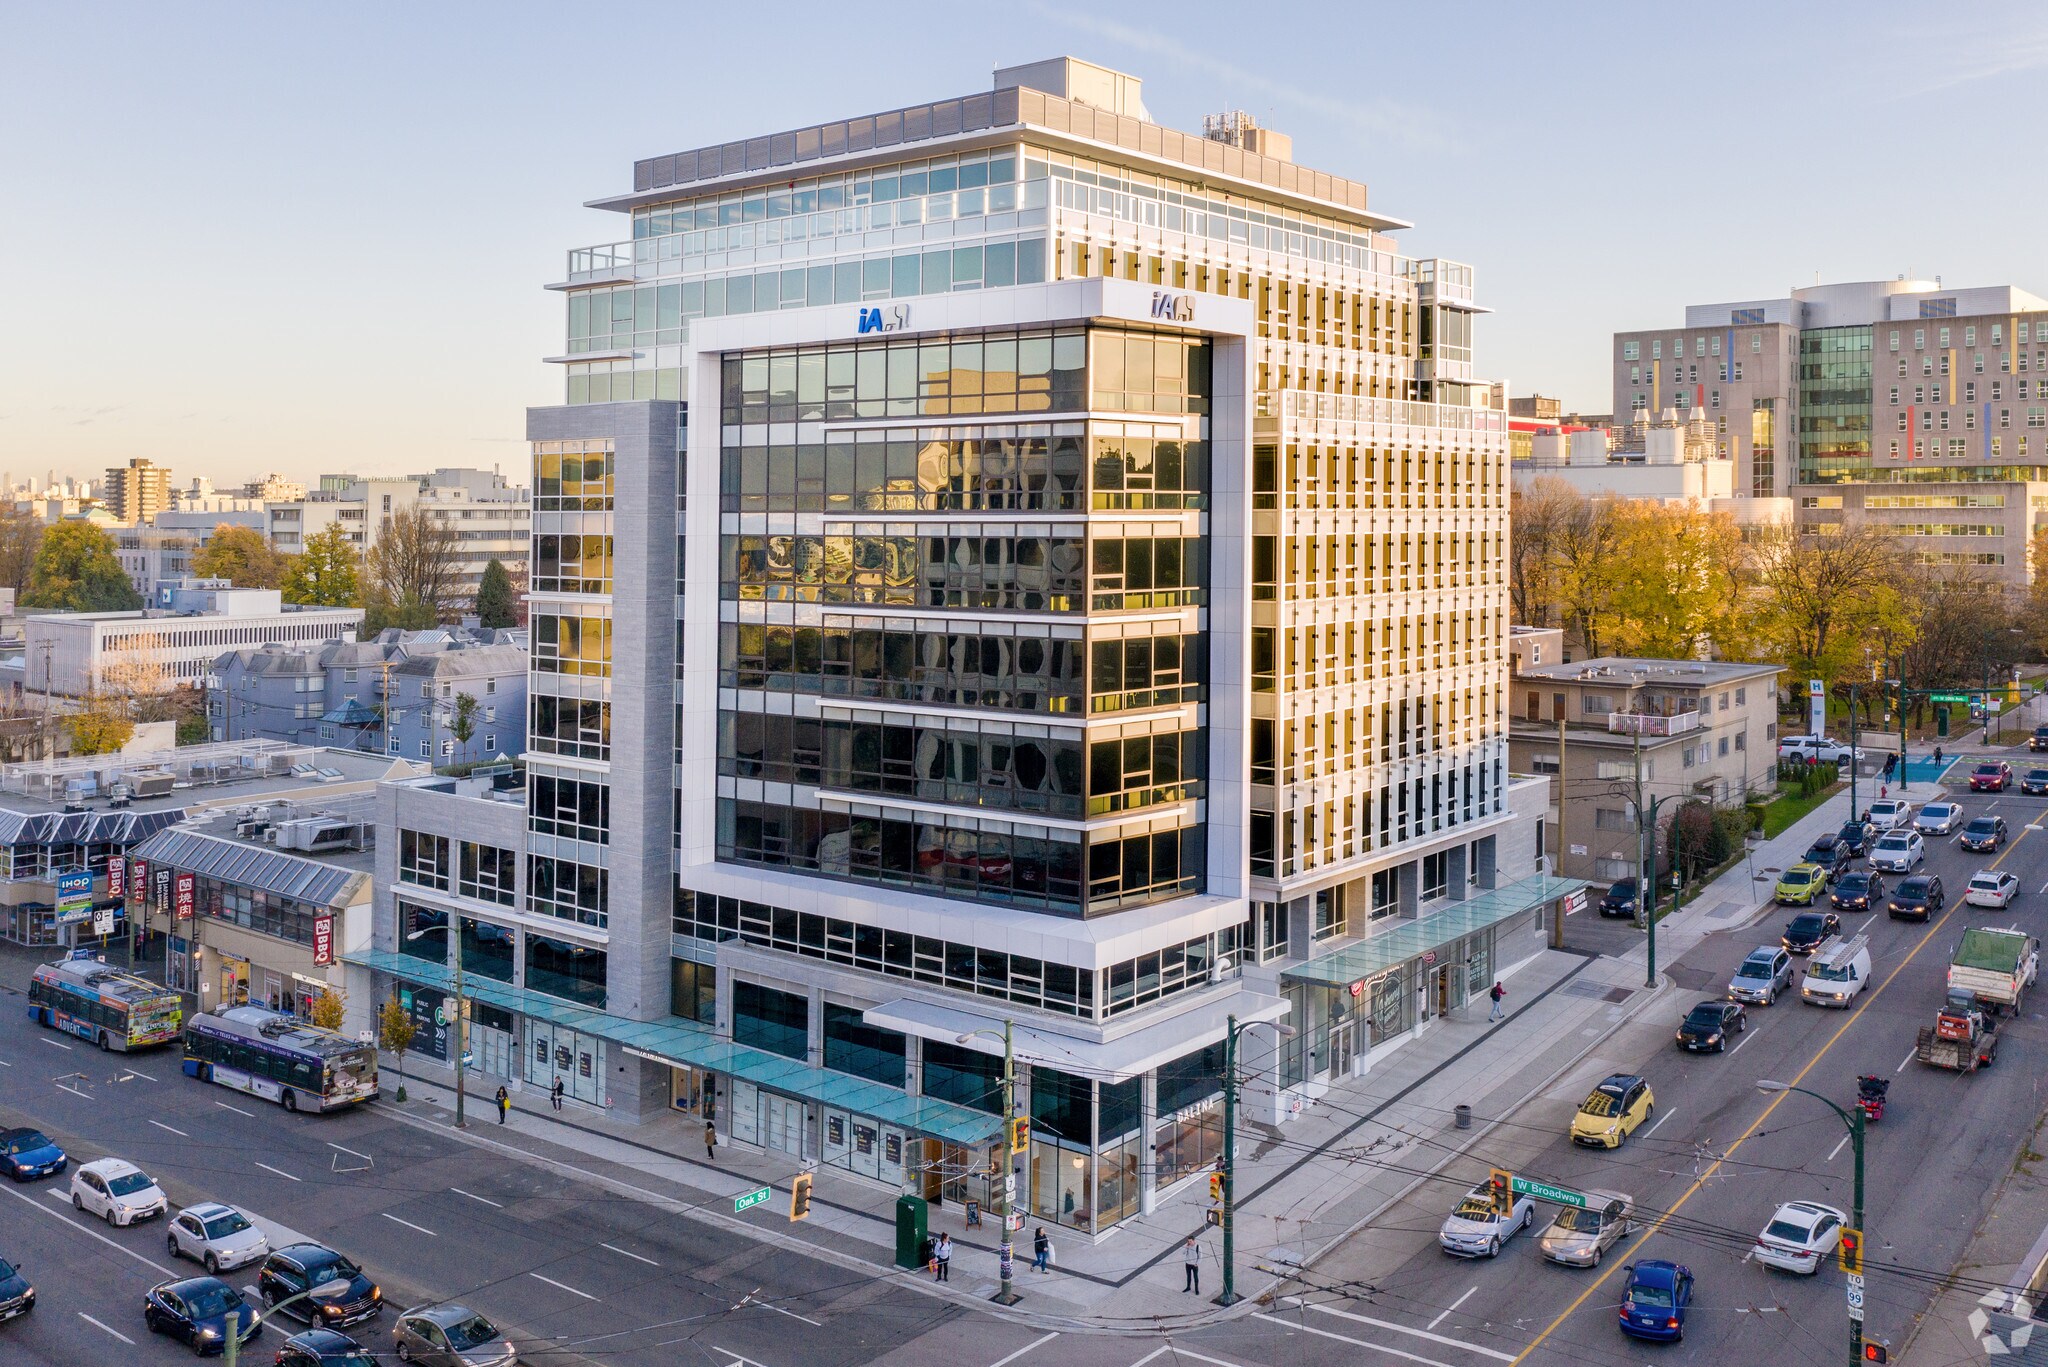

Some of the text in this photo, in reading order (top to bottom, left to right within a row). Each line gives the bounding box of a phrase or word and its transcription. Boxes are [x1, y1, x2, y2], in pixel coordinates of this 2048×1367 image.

[858, 307, 883, 334] iA
[61, 877, 90, 889] IHOP
[109, 871, 121, 894] BBQ
[315, 936, 328, 962] BBQ
[416, 999, 429, 1008] PUBLIC
[416, 1014, 431, 1023] PARKING
[59, 1019, 80, 1036] ADVENT
[338, 1057, 364, 1068] BoConcept
[1176, 1098, 1214, 1125] DALINA
[738, 1191, 767, 1209] Oak St
[1517, 1181, 1581, 1205] W Broadway
[1851, 1275, 1861, 1284] TO
[1849, 1292, 1861, 1303] 99
